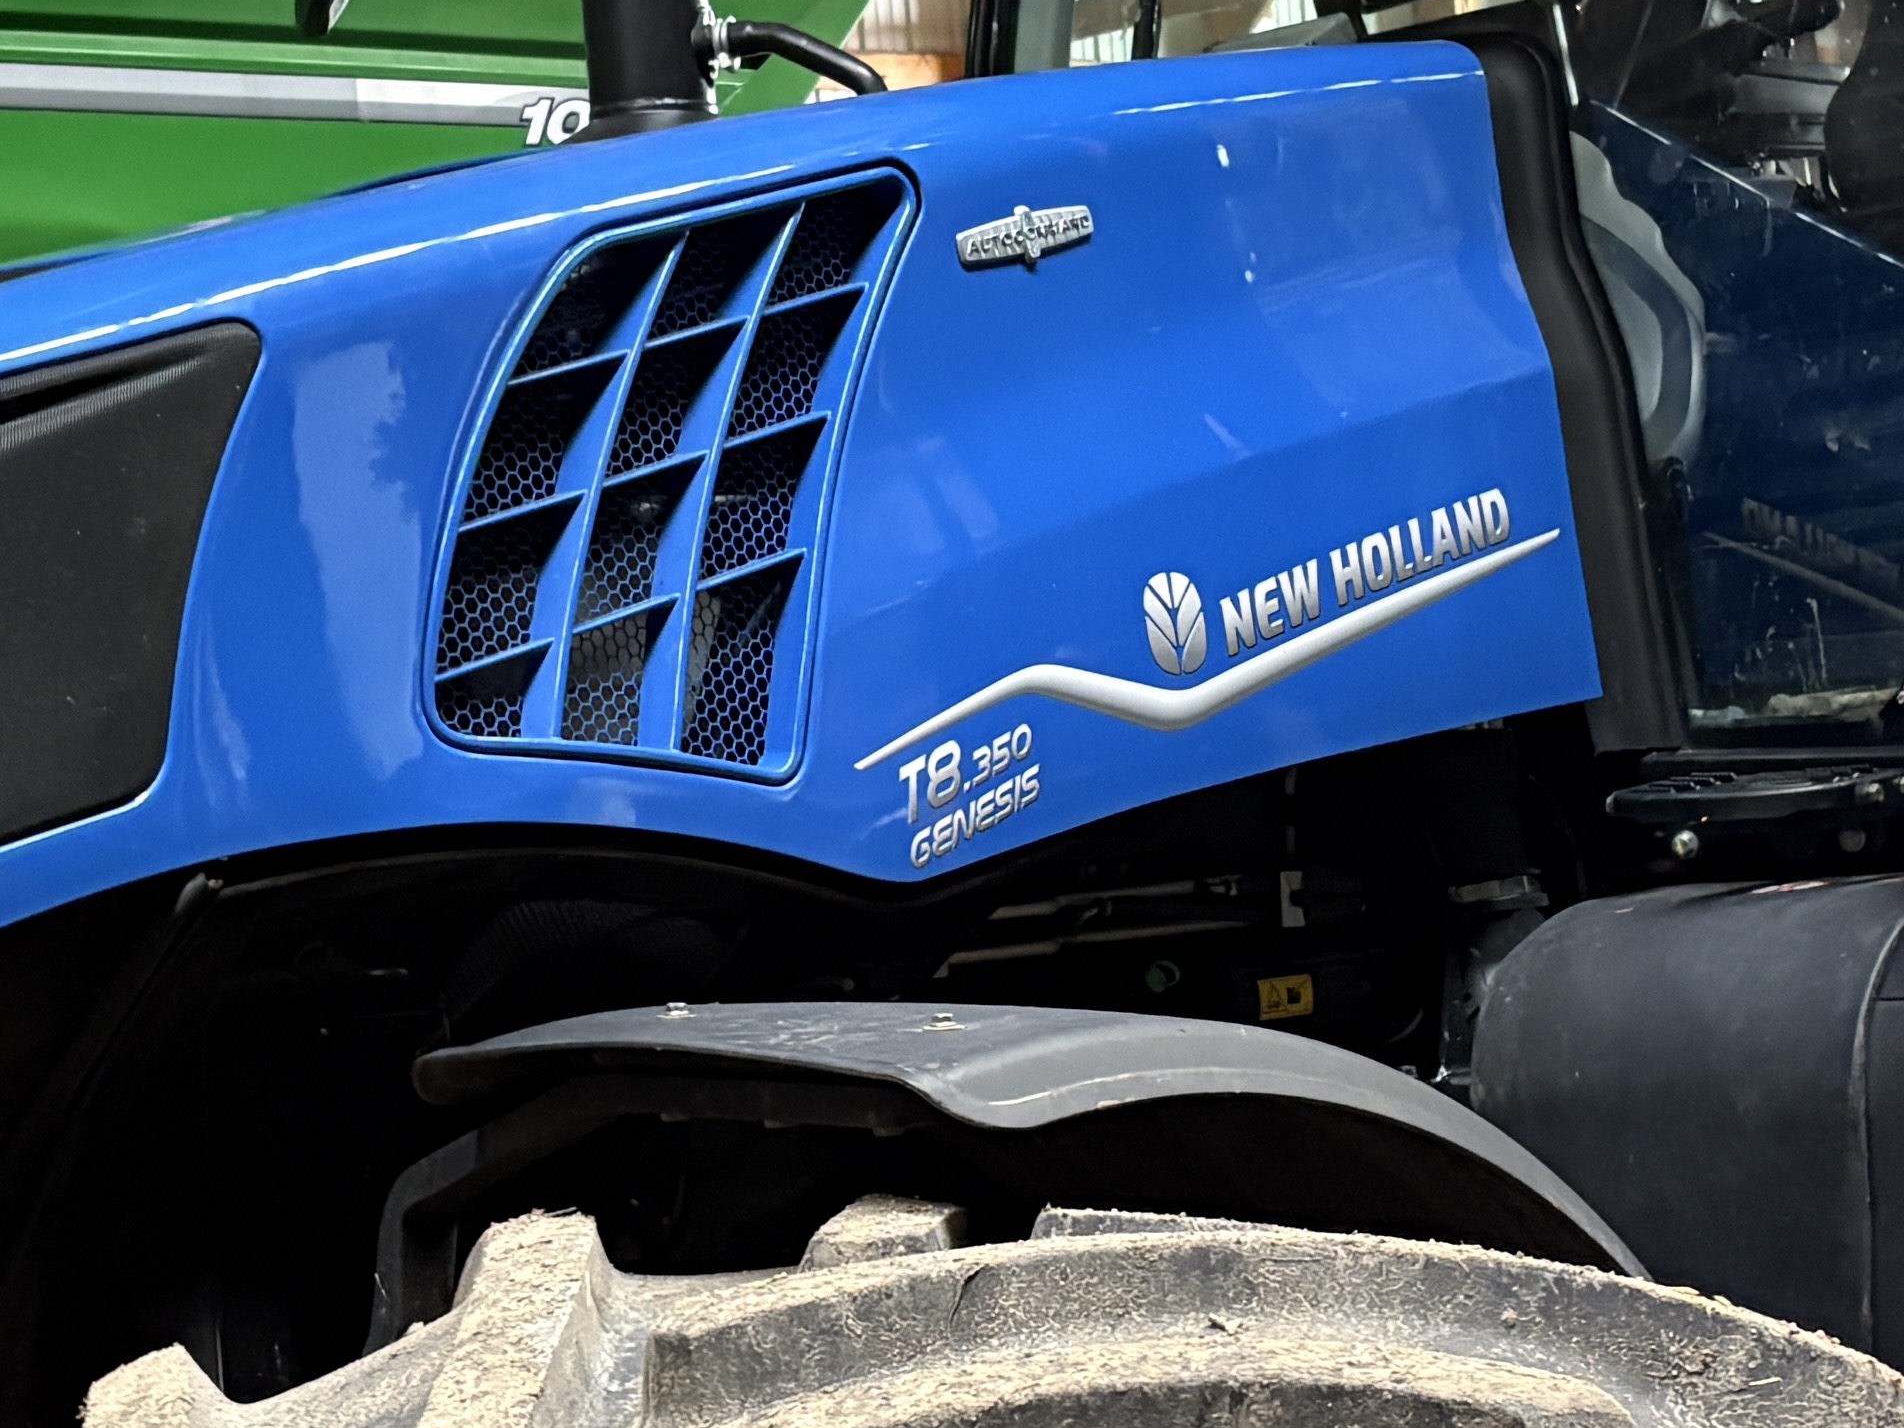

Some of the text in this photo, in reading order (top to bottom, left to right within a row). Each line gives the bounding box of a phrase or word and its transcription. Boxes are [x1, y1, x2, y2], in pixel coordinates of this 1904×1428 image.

[1219, 487, 1511, 658] NEW HOLLAND
[898, 723, 1033, 825] T8.350
[909, 763, 1041, 870] GENESIS
